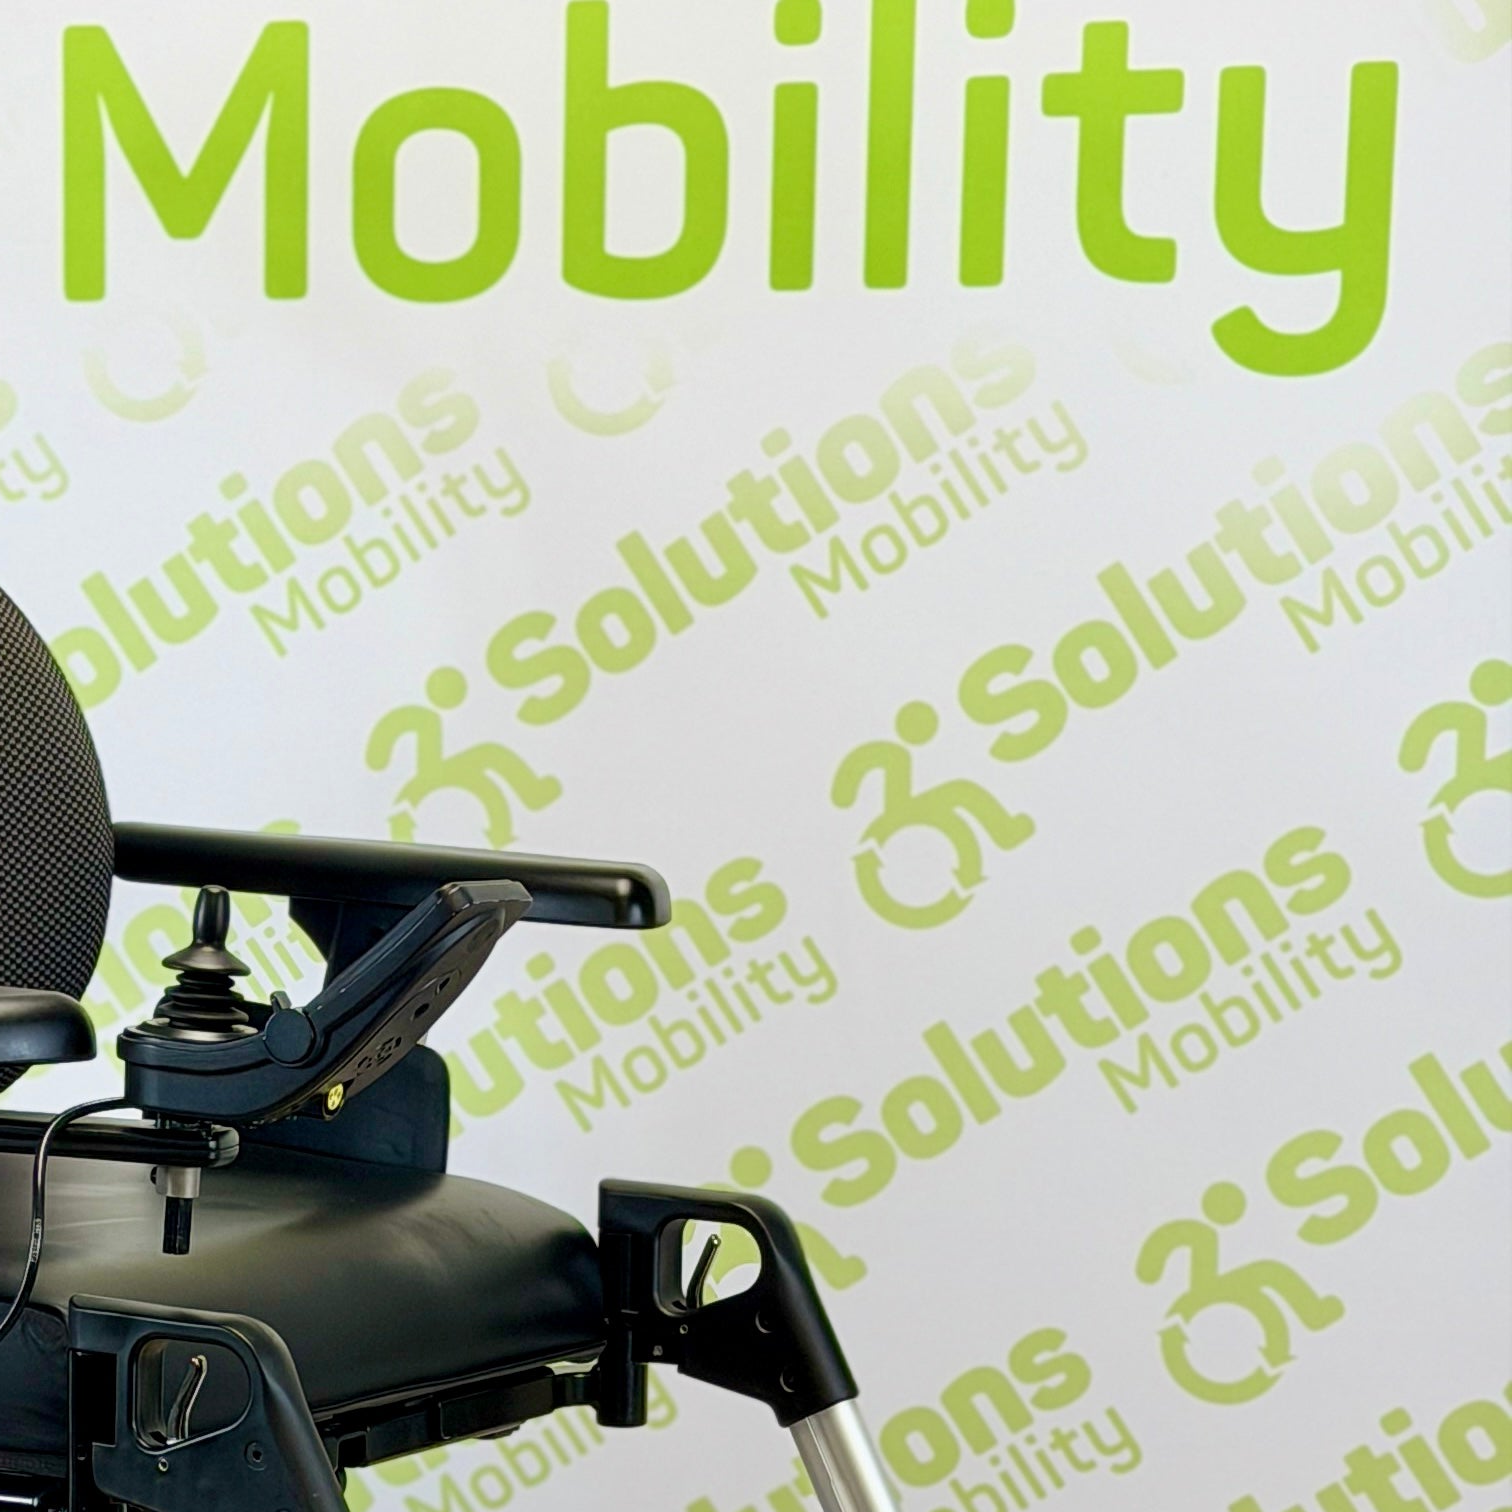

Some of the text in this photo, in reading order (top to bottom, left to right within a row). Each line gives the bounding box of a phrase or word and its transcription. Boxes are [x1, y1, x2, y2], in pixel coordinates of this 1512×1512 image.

[62, 0, 1399, 378] Mobility
[50, 366, 481, 713] olutions
[249, 444, 531, 658] Mobility
[484, 332, 1038, 727] Solutions
[788, 397, 1090, 620] Mobility
[1279, 454, 1512, 655] Mobili
[449, 856, 788, 1140] utions
[554, 936, 838, 1133] Mobility
[789, 825, 1352, 1208] Solutions
[1097, 908, 1404, 1115] Mobility
